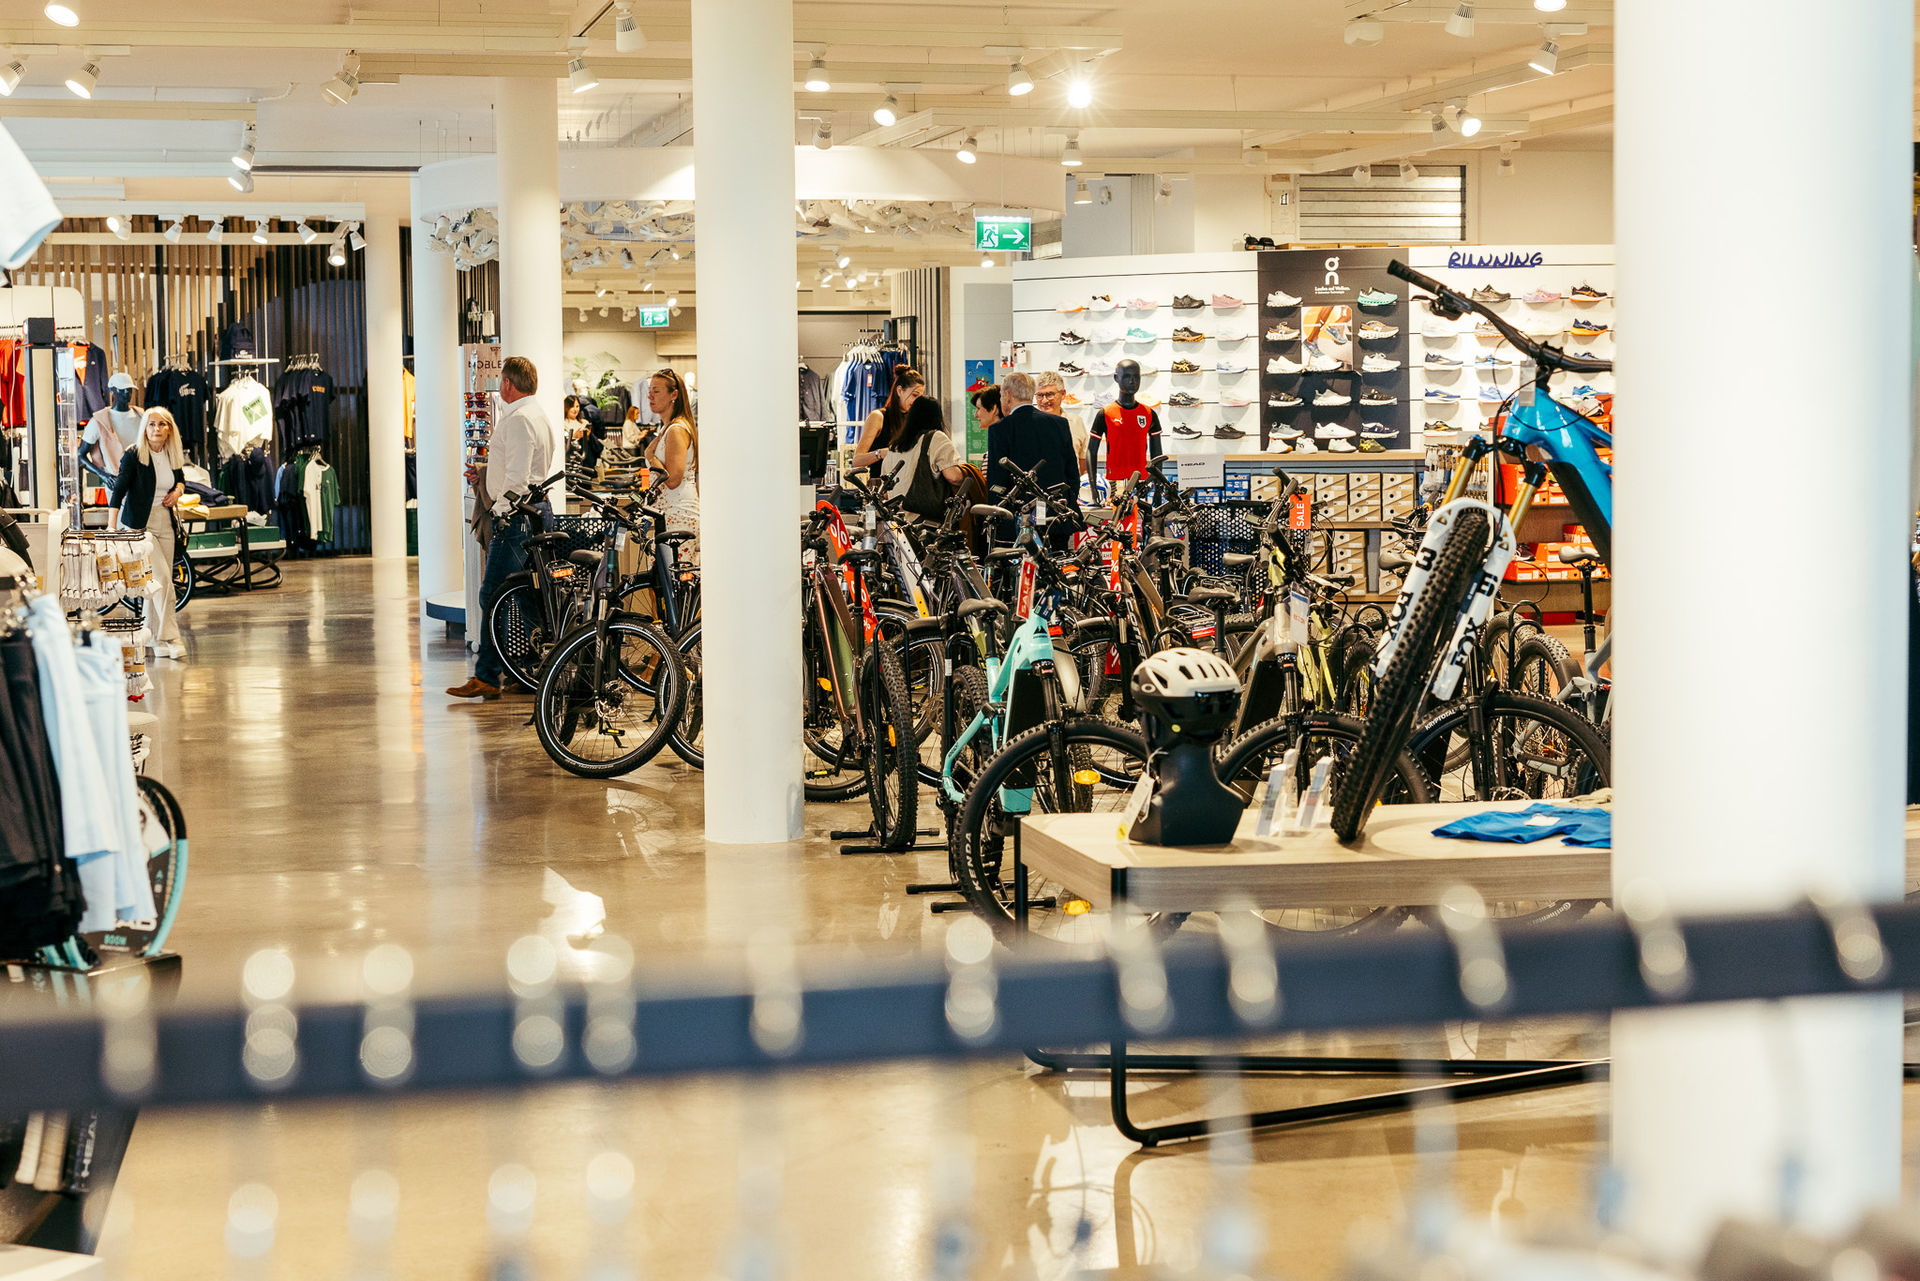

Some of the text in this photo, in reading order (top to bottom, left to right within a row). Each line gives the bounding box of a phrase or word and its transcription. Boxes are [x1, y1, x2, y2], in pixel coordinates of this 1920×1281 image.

[1448, 251, 1543, 269] RUNNING
[1296, 503, 1305, 526] SALE
[1020, 577, 1030, 614] SALE
[1450, 617, 1480, 668] FOX
[965, 832, 983, 891] KENDA
[81, 1112, 97, 1178] HEA
